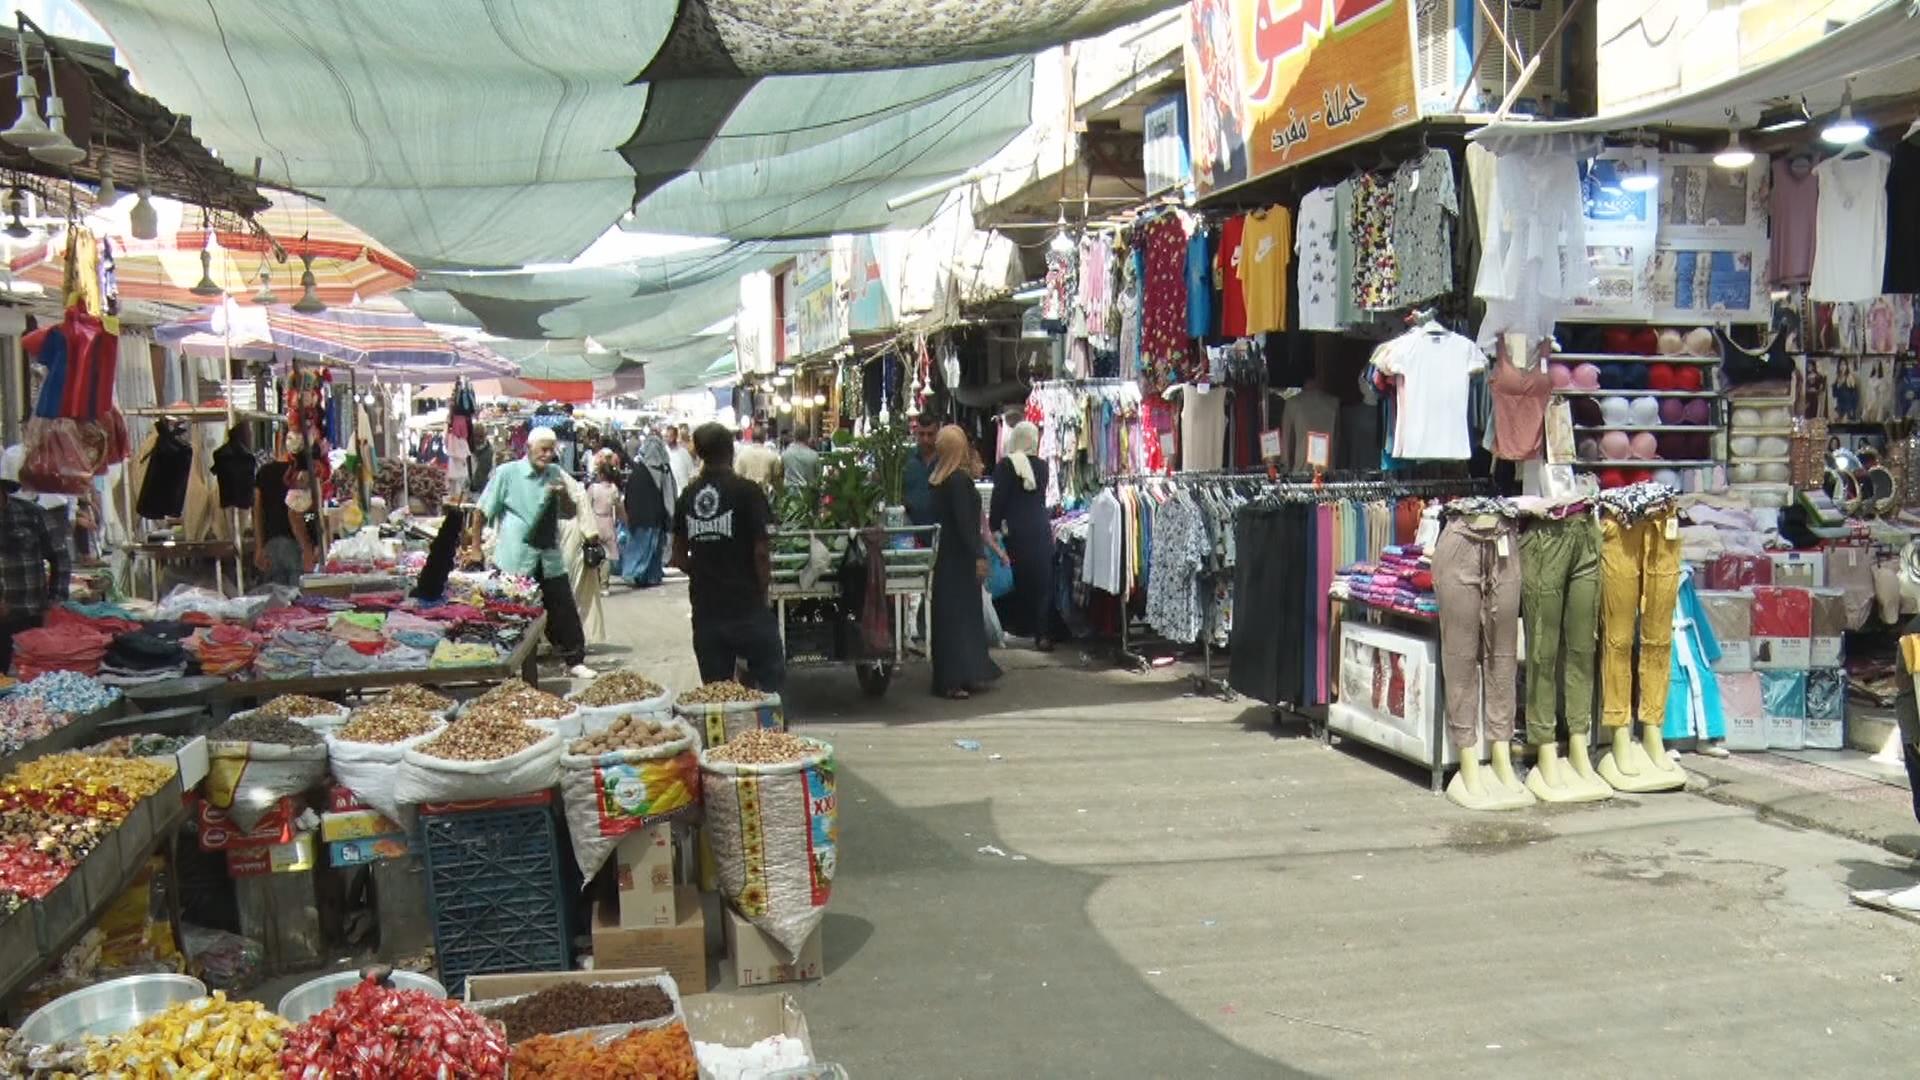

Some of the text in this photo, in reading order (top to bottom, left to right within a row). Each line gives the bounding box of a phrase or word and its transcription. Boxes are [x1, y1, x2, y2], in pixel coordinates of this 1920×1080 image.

[1324, 84, 1366, 128] جملة
[1271, 108, 1308, 159] مفرد
[814, 796, 836, 815] XX
